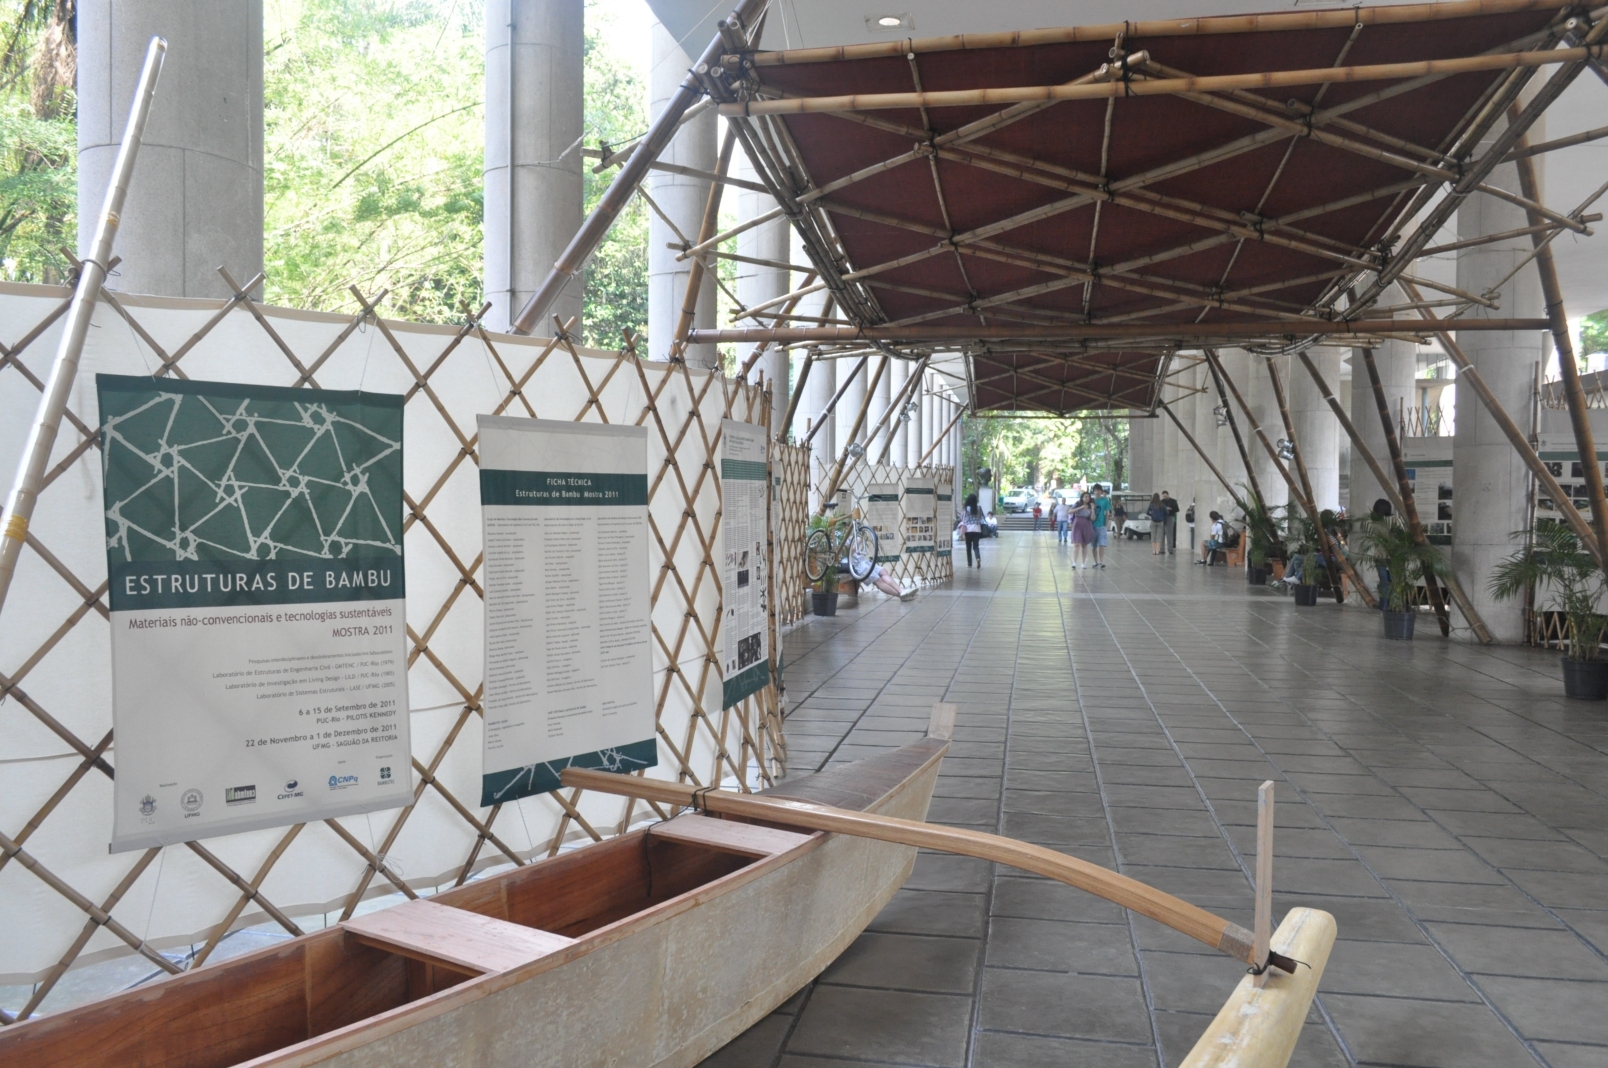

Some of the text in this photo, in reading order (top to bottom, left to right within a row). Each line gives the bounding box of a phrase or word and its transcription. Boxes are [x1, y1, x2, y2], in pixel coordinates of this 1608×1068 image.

[547, 477, 592, 486] FICHA TÉCNICA
[515, 489, 549, 498] Estruturas
[551, 490, 560, 498] de
[562, 490, 580, 498] Bambu
[605, 490, 619, 498] 2011
[125, 569, 391, 595] ESTRUTURAS DE BAMBU
[128, 606, 393, 630] Materiais não-convencionais e tecnologias sustentáveis
[332, 625, 393, 638] MOSTRA 2011
[212, 670, 244, 679] Laboratório
[225, 681, 257, 690] Laboratório
[256, 692, 287, 700] Laboratório
[323, 706, 333, 714] de
[334, 703, 366, 712] Setembro
[380, 700, 396, 708] 2011
[316, 716, 340, 724] PUC-Rio
[346, 713, 368, 721] PILOTIS
[369, 710, 397, 719] KENNEDY
[245, 739, 255, 748] 22
[257, 738, 268, 746] de
[269, 735, 308, 745] Novembro
[323, 731, 332, 739] de
[334, 728, 368, 738] Dezembro
[381, 724, 397, 732] 2011
[312, 742, 331, 750] UFMG
[336, 738, 360, 748] SAGUÃO
[361, 737, 370, 745] DA
[371, 734, 398, 743] REITORIA
[337, 775, 358, 784] CNPq
[184, 811, 200, 819] UFMG
